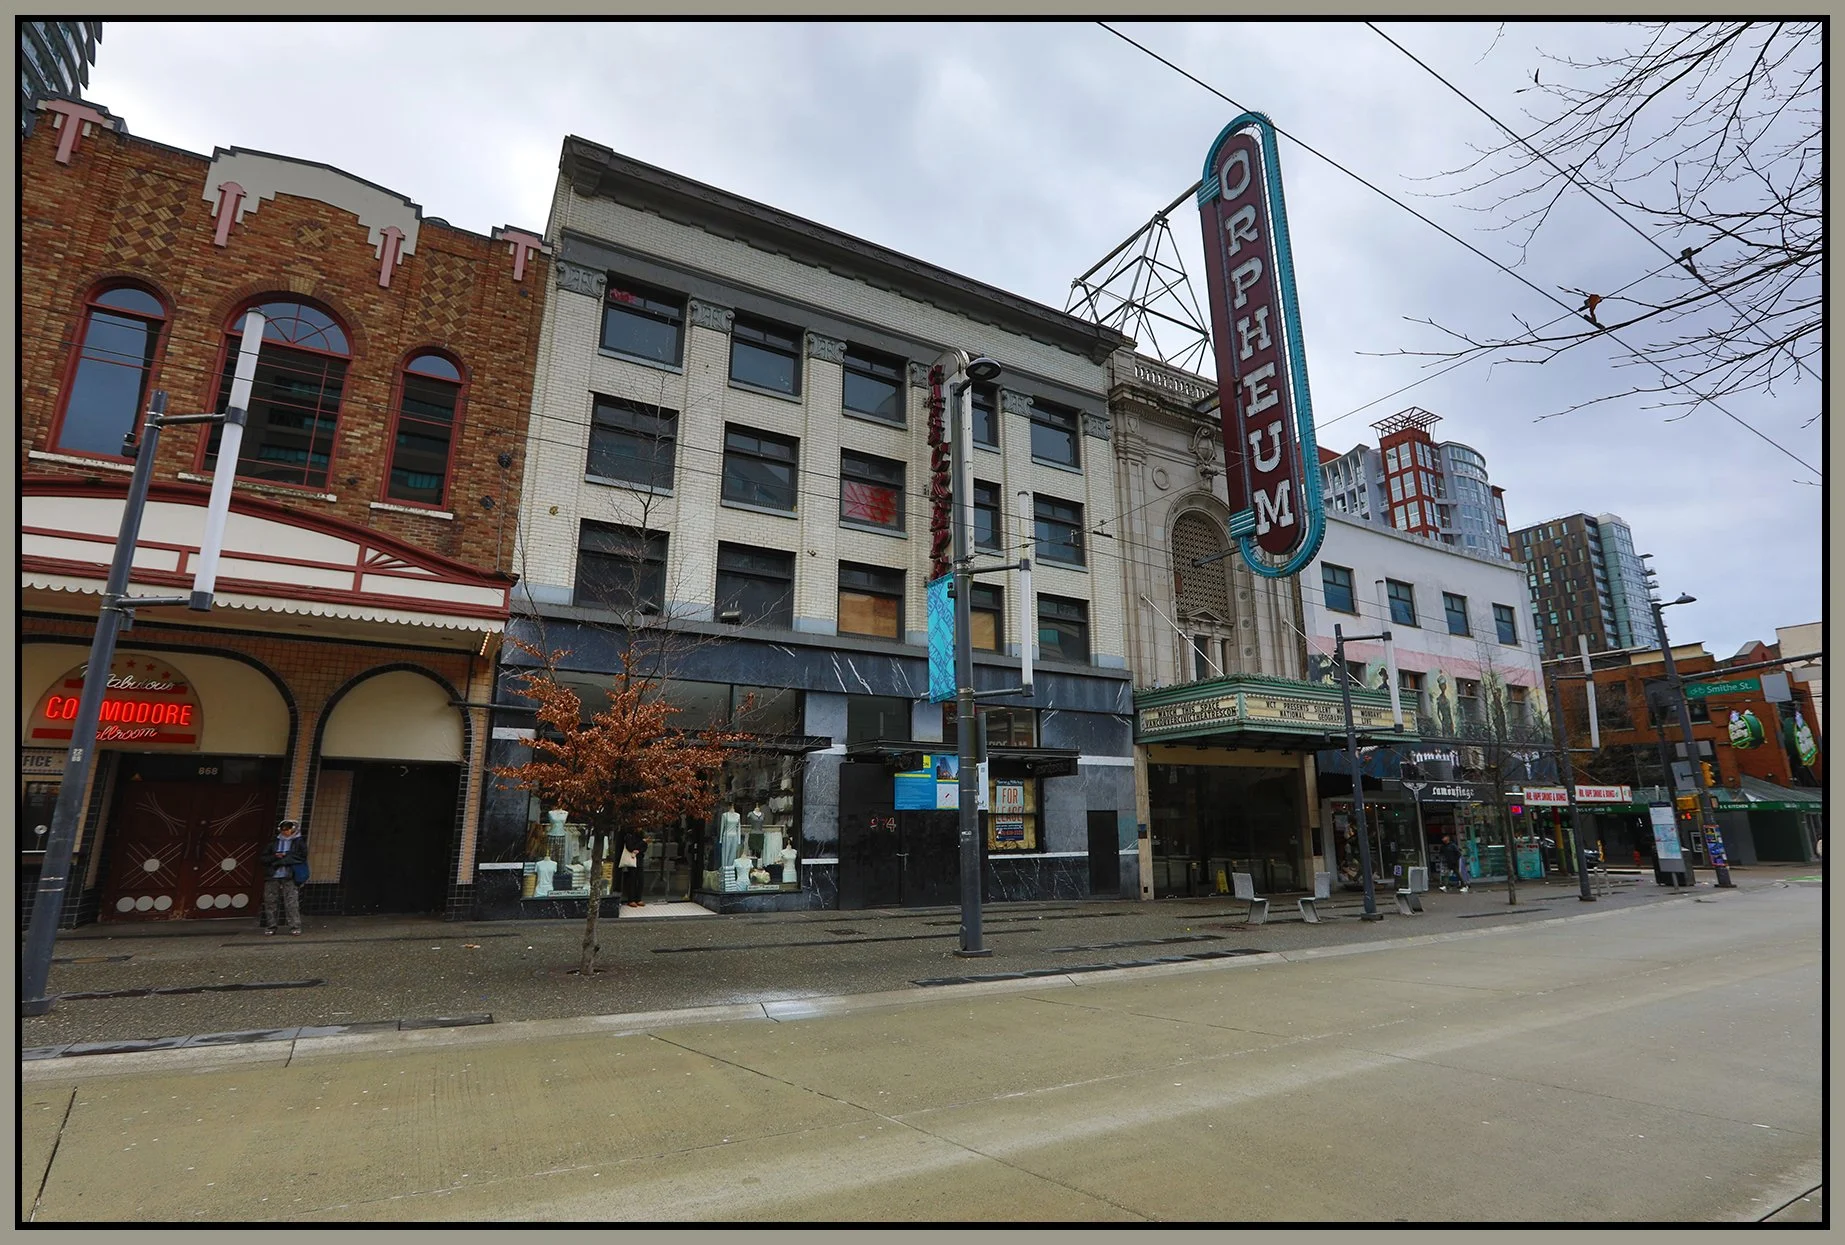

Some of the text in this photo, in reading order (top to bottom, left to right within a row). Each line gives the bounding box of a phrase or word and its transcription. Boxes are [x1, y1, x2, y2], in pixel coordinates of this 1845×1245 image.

[1218, 148, 1294, 537] ORPHEUM
[1706, 682, 1753, 694] Smithe St.
[46, 695, 193, 726] COMODORE
[1158, 701, 1220, 719] WATCH THIS SPACE
[1280, 710, 1306, 720] NATIONAL
[1361, 718, 1372, 726] LIVE
[1284, 702, 1310, 712] PRESENTS
[1313, 705, 1331, 714] SILENT
[1360, 710, 1383, 719] MONDAYS
[96, 724, 158, 742] allroom
[1002, 788, 1018, 804] FOR
[996, 806, 1023, 823] LEASE
